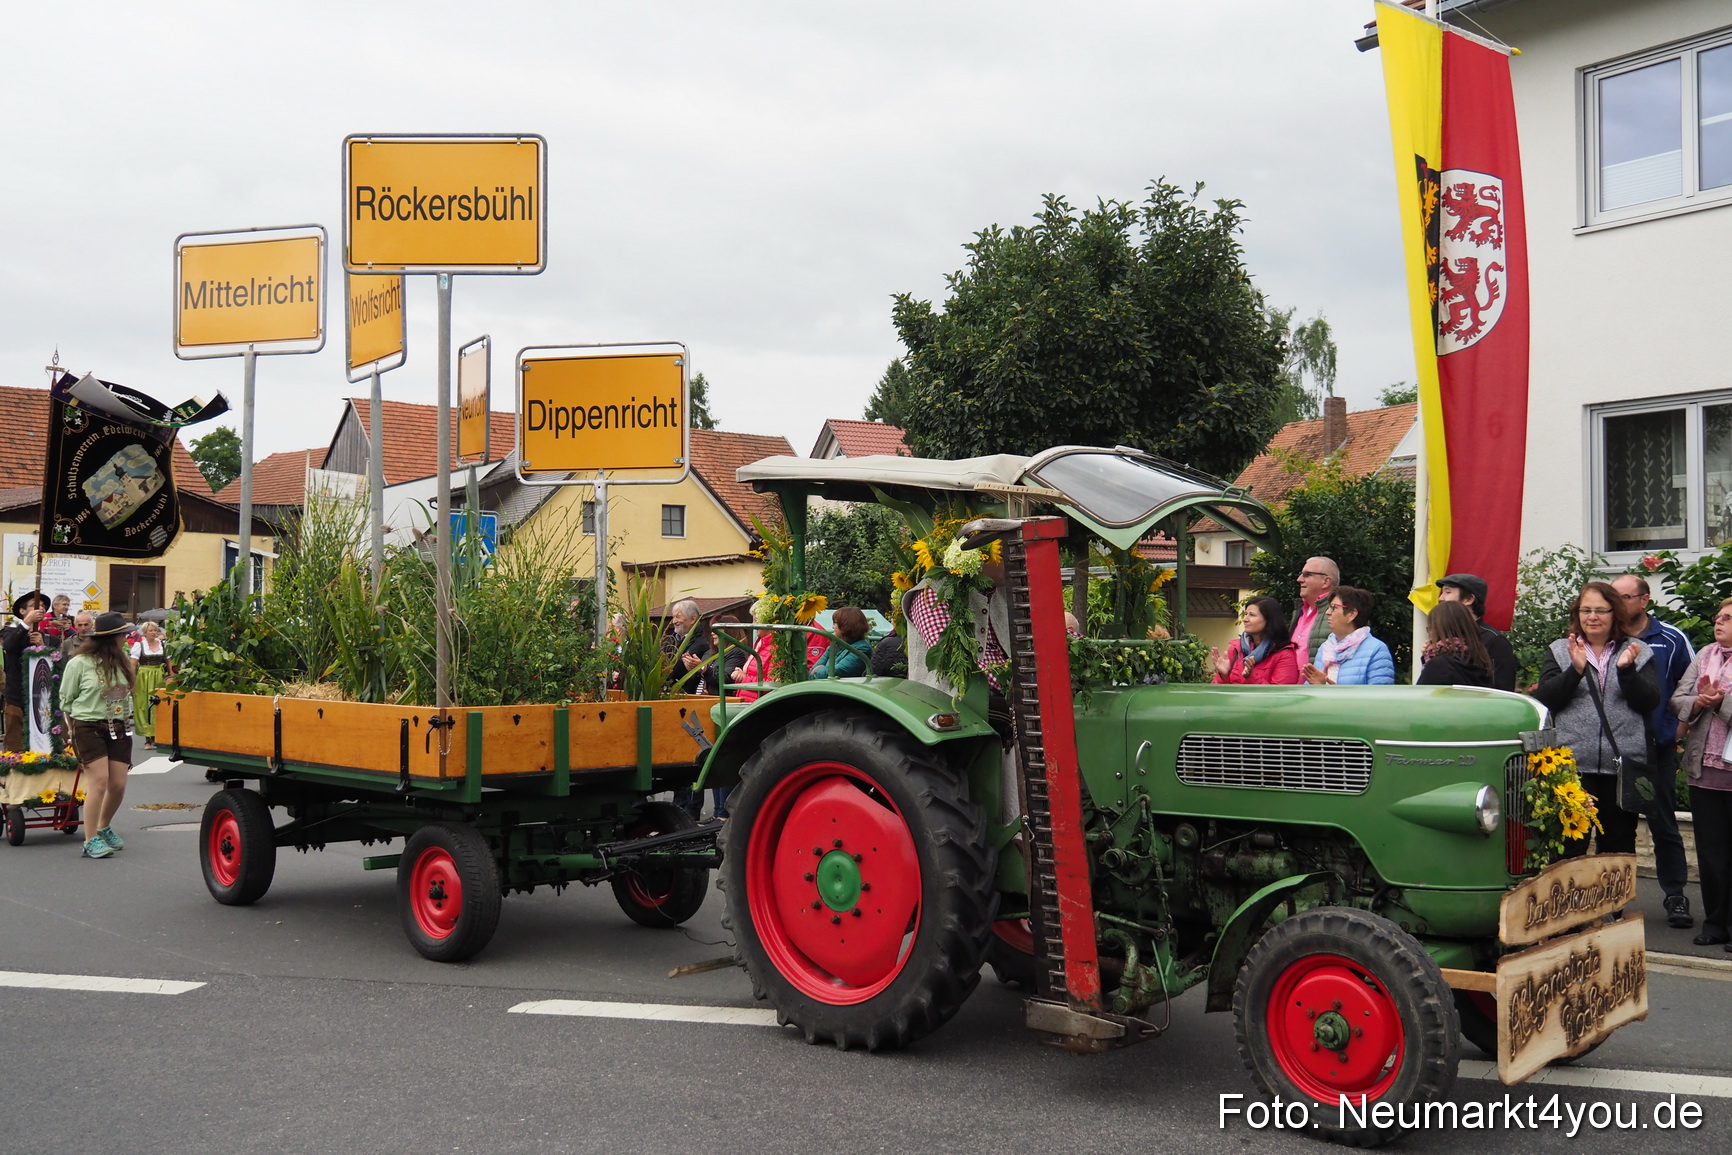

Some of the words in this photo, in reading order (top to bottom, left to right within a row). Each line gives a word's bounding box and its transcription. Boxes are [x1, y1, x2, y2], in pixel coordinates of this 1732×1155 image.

[355, 186, 534, 222] Röckersbühl
[182, 274, 315, 311] Mittelricht
[351, 279, 401, 328] Wolfsricht
[528, 396, 678, 439] Dippenricht
[75, 508, 91, 524] 1964
[16, 541, 71, 567] HZPROFI
[1385, 752, 1455, 766] Farmer
[1525, 893, 1550, 929] Das
